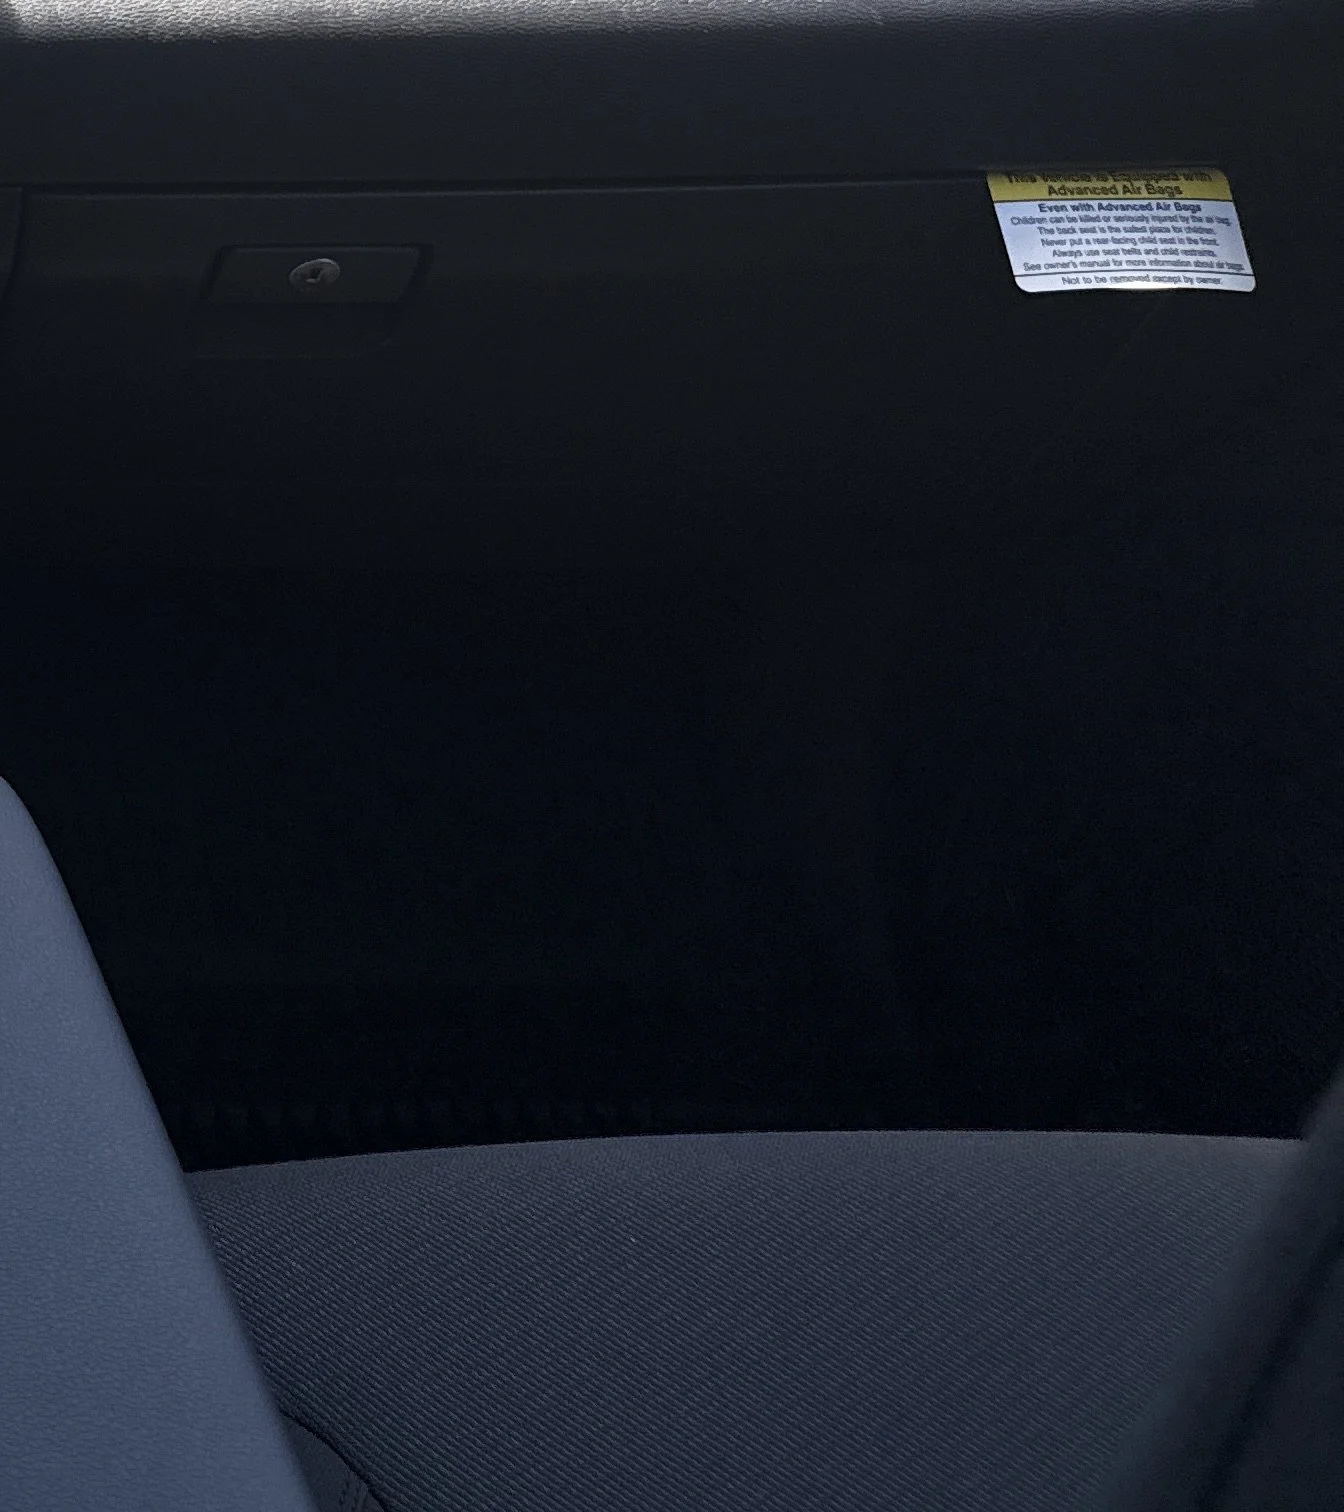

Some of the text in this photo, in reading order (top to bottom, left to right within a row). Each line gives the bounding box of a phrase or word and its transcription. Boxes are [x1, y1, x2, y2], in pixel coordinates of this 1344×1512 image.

[1048, 183, 1183, 197] Advanced Air Bags
[1038, 201, 1202, 213] Even with Advanced Air Bags
[1061, 275, 1080, 285] Not
